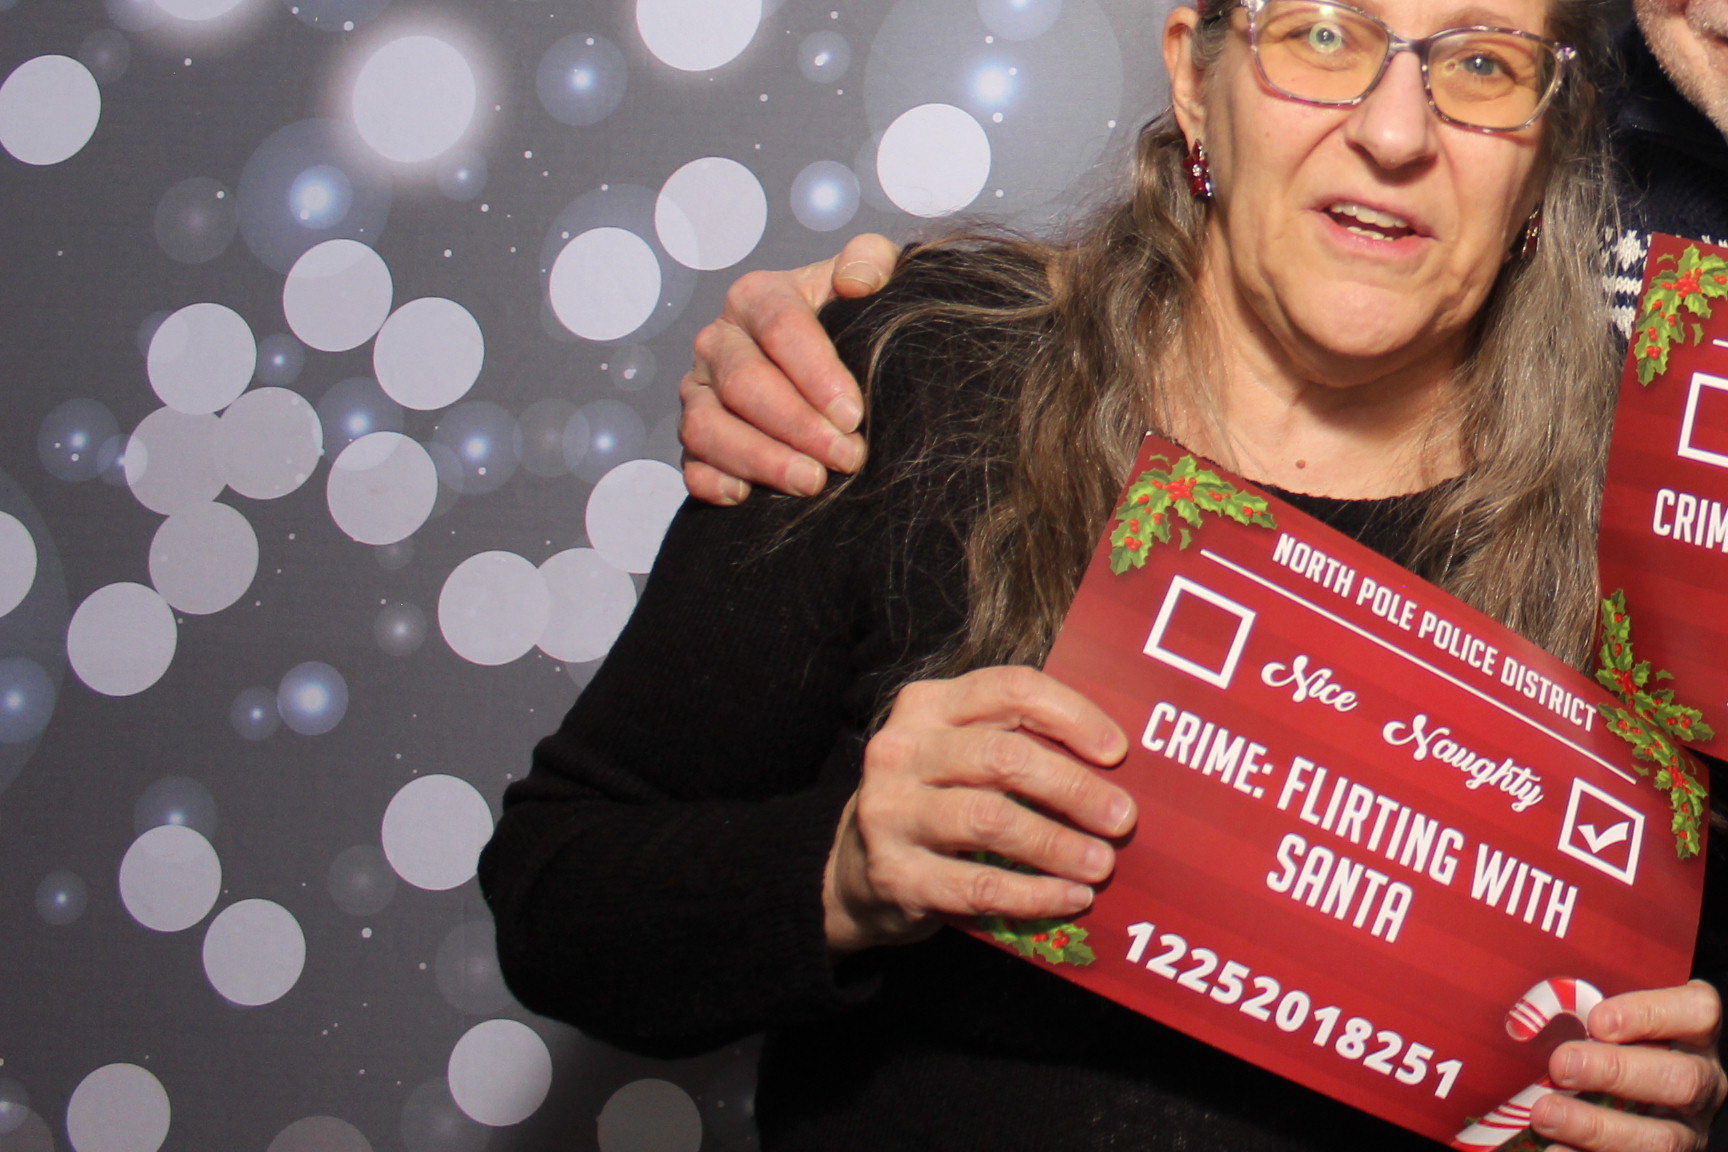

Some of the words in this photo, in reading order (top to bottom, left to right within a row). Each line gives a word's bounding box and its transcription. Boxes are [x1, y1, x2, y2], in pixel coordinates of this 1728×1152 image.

[1272, 532, 1356, 598] NORTH
[1355, 577, 1418, 631] POLE
[1417, 610, 1499, 676] POLICE
[1500, 656, 1597, 732] DISTRICT
[1141, 701, 1274, 799] CRIME:
[1276, 756, 1465, 886] FLIRTING
[1470, 842, 1578, 939] WITH
[1260, 654, 1358, 712] Nice
[1382, 713, 1544, 811] Naughty
[1266, 833, 1413, 943] SANTA
[1125, 921, 1463, 1099] 12252018251
